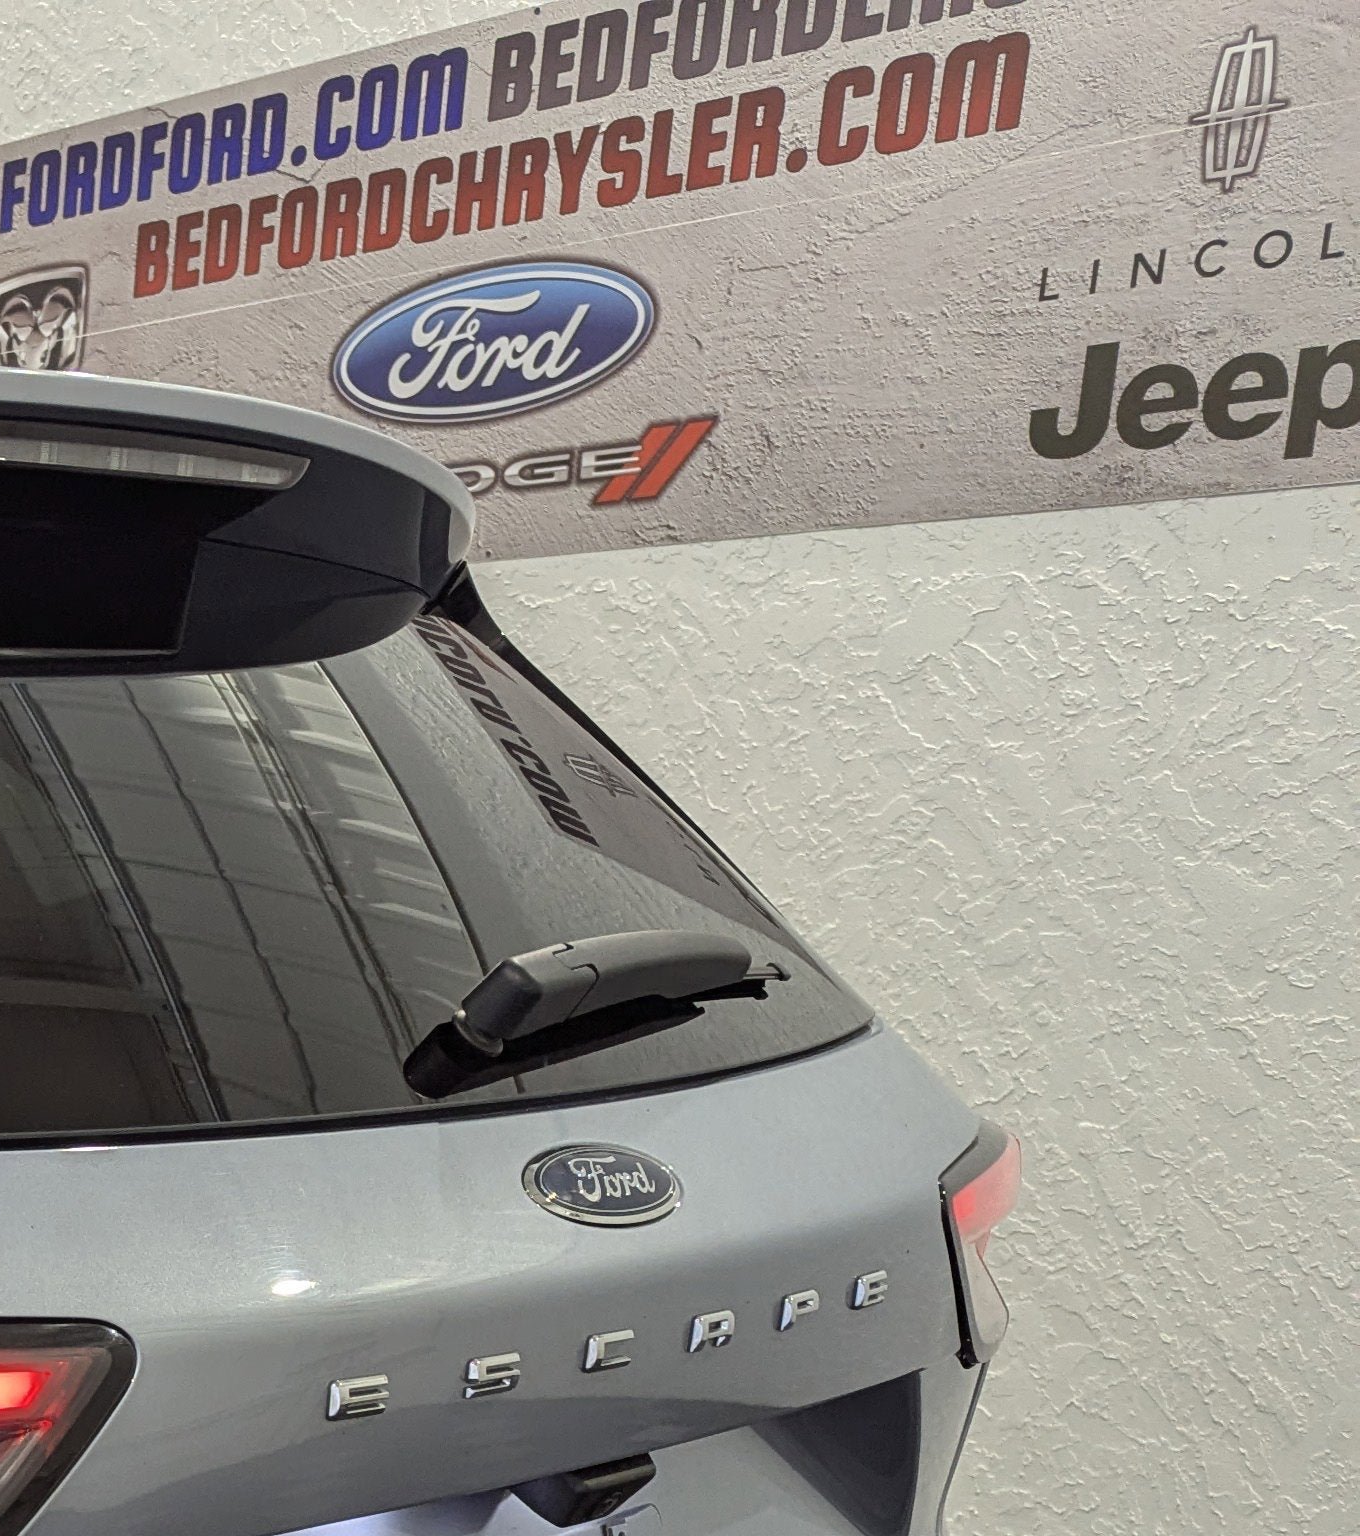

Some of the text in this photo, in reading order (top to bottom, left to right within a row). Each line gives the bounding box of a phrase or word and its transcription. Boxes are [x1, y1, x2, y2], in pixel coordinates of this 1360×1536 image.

[133, 31, 1030, 298] BEDFORDCHRYSLER.COM
[389, 289, 590, 399] Ford
[1029, 339, 1360, 460] Jeep
[570, 1154, 657, 1203] Ford
[326, 1269, 888, 1421] ESCAPE
